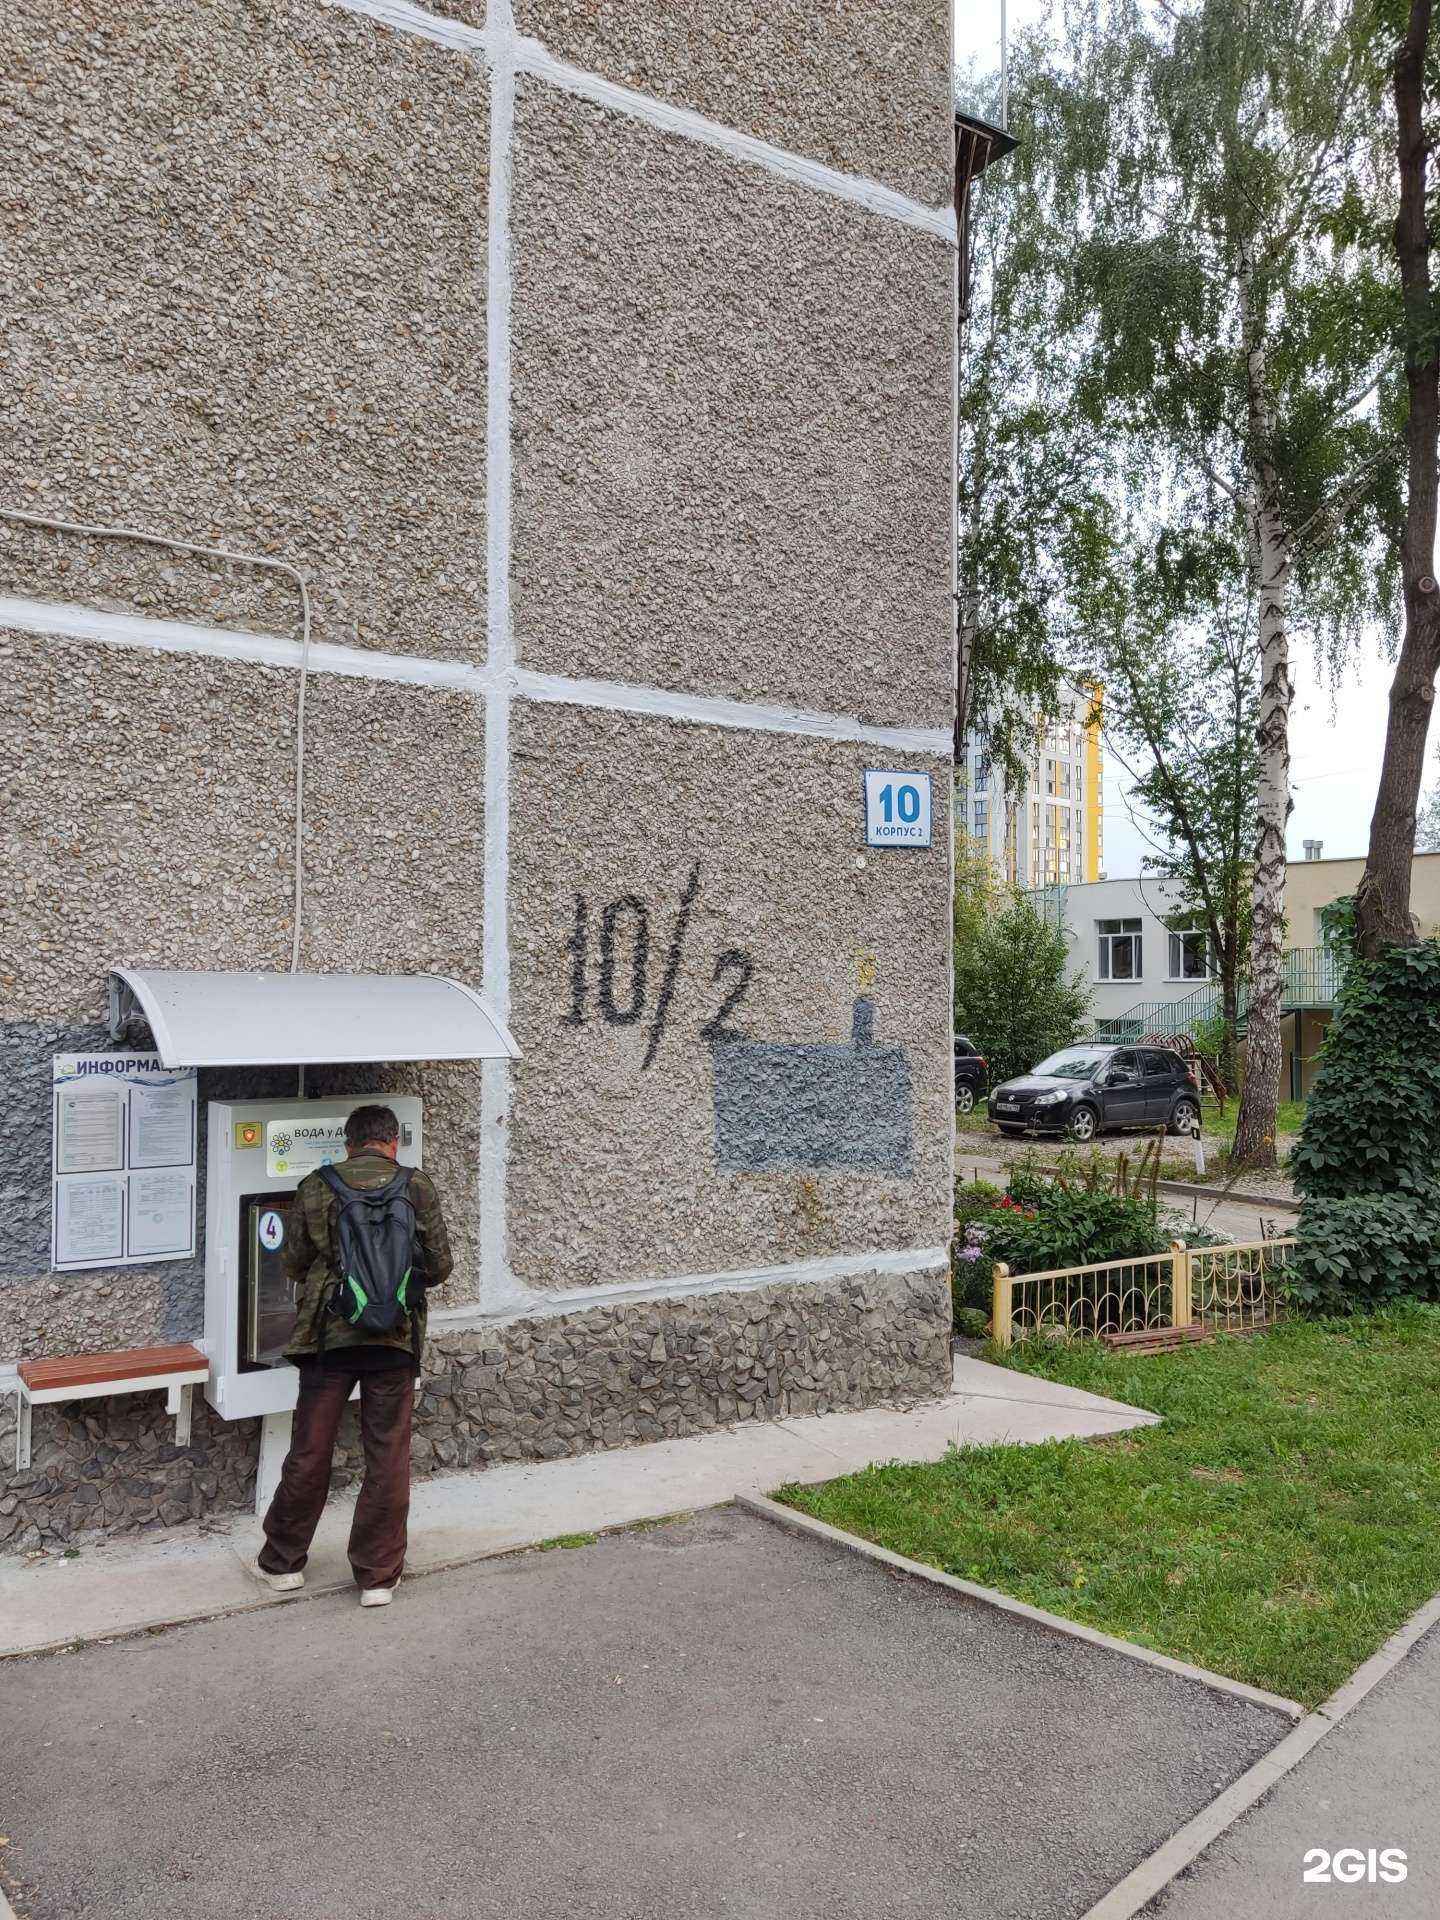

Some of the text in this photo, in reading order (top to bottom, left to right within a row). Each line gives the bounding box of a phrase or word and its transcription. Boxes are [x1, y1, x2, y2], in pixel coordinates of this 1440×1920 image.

[879, 783, 920, 823] 10
[876, 826, 916, 837] КОРПУС
[561, 861, 752, 1070] 10/2
[76, 1059, 194, 1074] ИНФОРМА
[294, 1128, 325, 1140] ВОДА
[266, 1215, 277, 1240] 4
